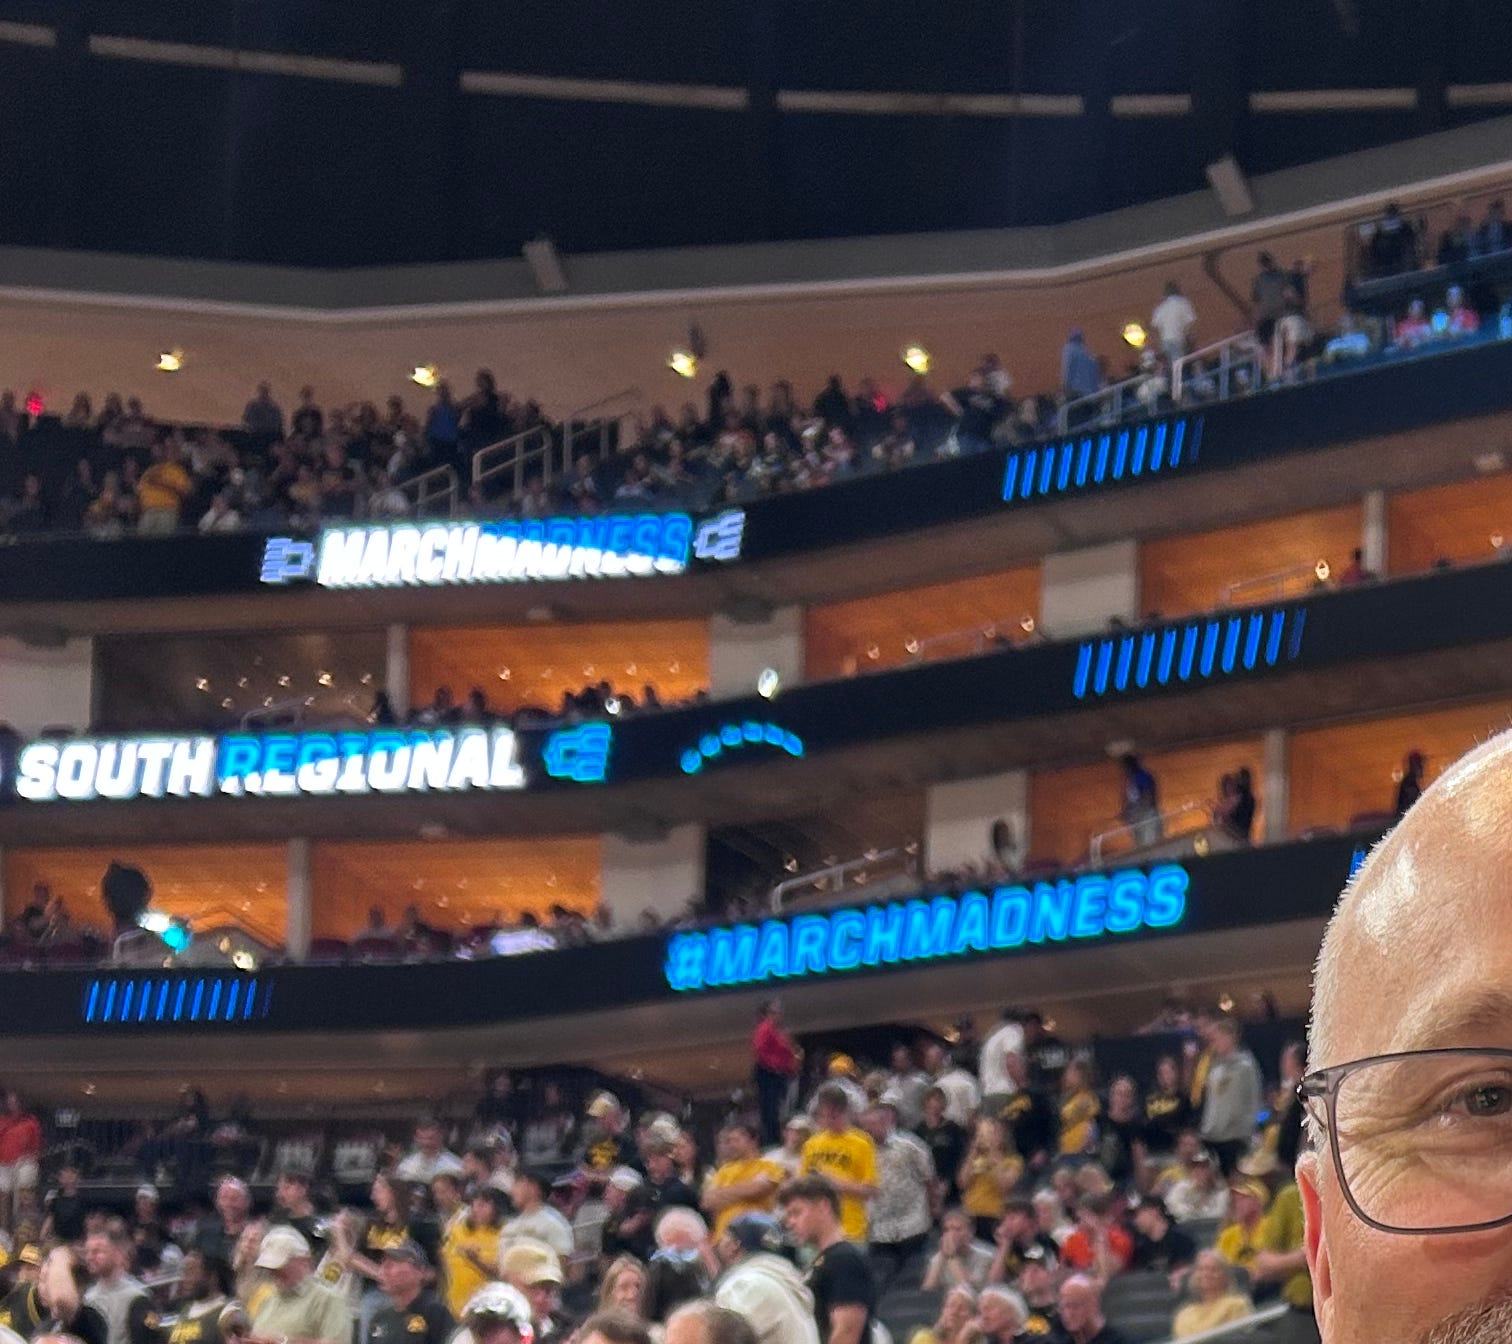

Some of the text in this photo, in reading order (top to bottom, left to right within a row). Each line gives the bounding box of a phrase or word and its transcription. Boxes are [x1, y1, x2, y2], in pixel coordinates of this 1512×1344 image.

[15, 727, 527, 800] SOUTH REGIONAL
[664, 863, 1190, 991] #MARCHMADNESS
